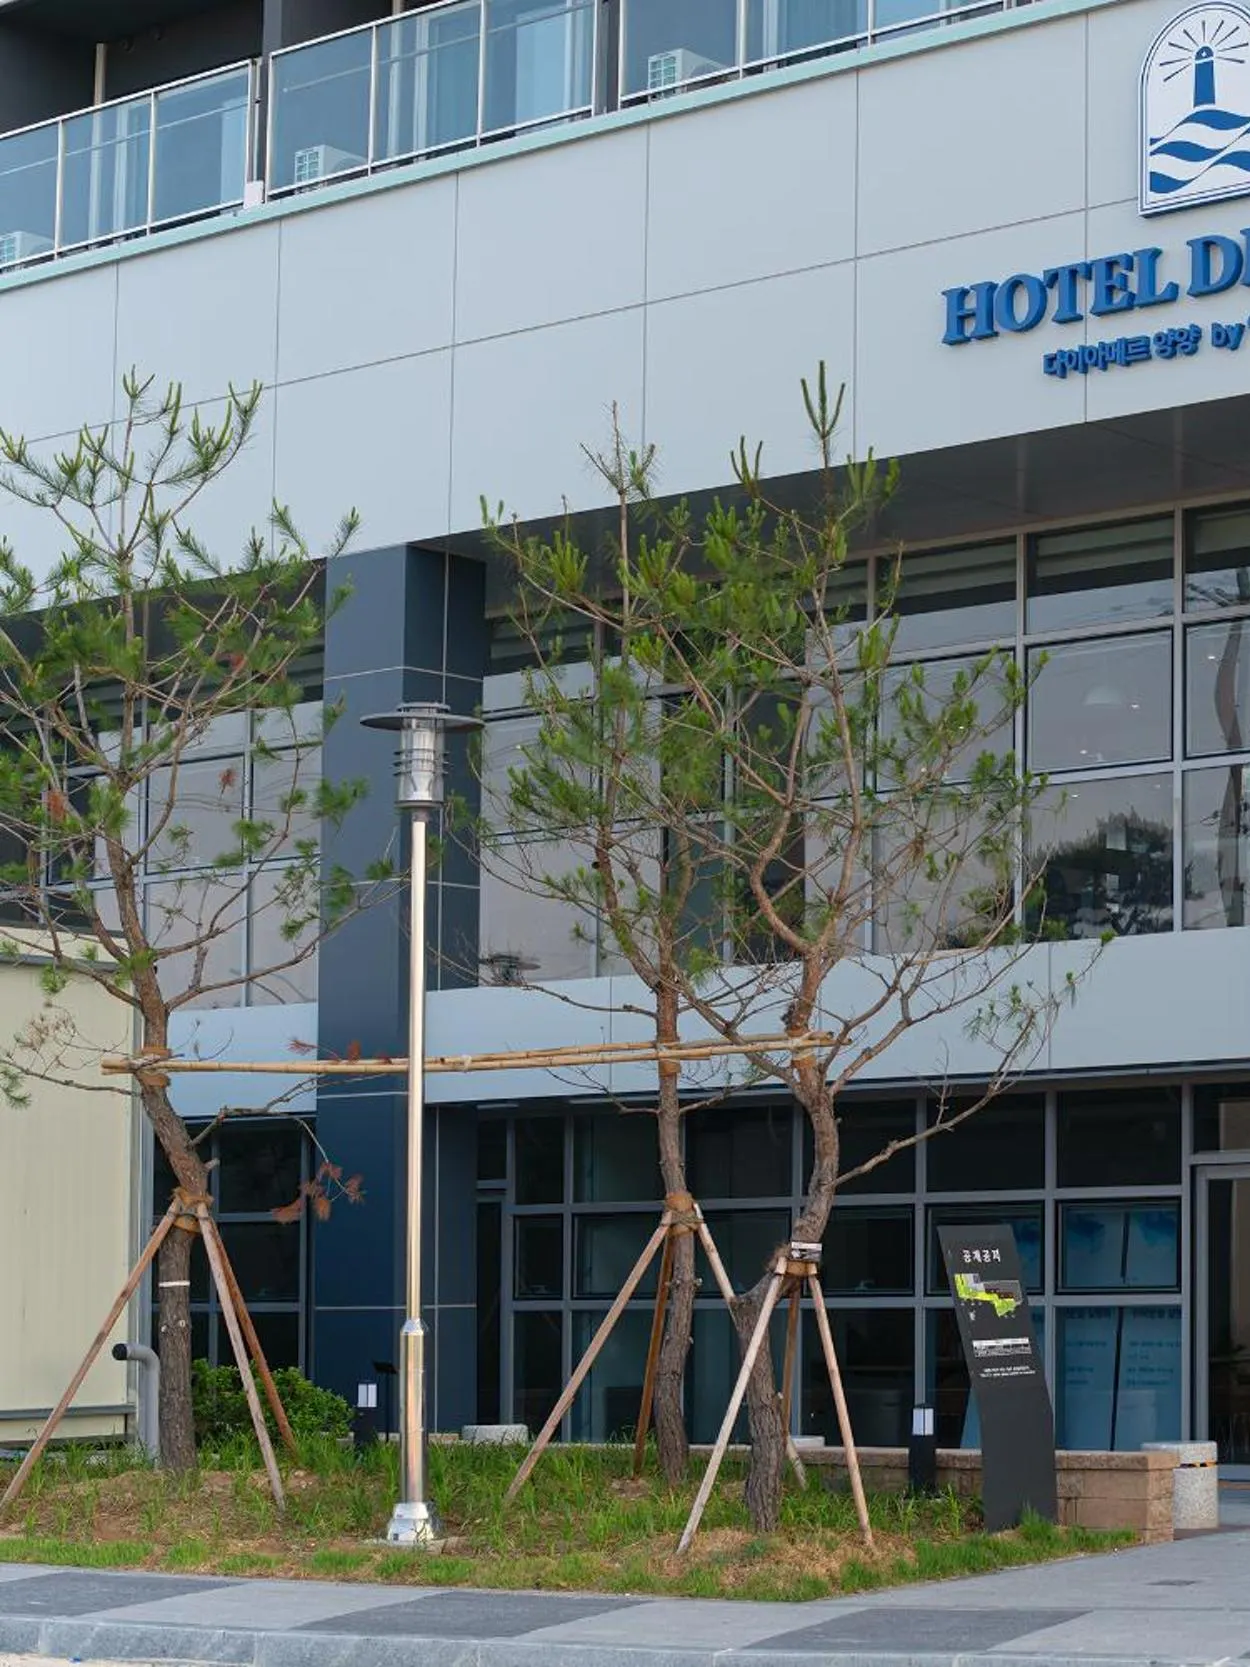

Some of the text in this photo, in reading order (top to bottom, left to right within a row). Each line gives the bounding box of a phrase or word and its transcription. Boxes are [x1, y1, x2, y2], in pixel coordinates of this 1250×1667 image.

[941, 246, 1180, 345] HOTEL
[1153, 323, 1203, 359] 양양
[1211, 321, 1246, 351] by
[962, 1248, 1001, 1264] 공개공지
